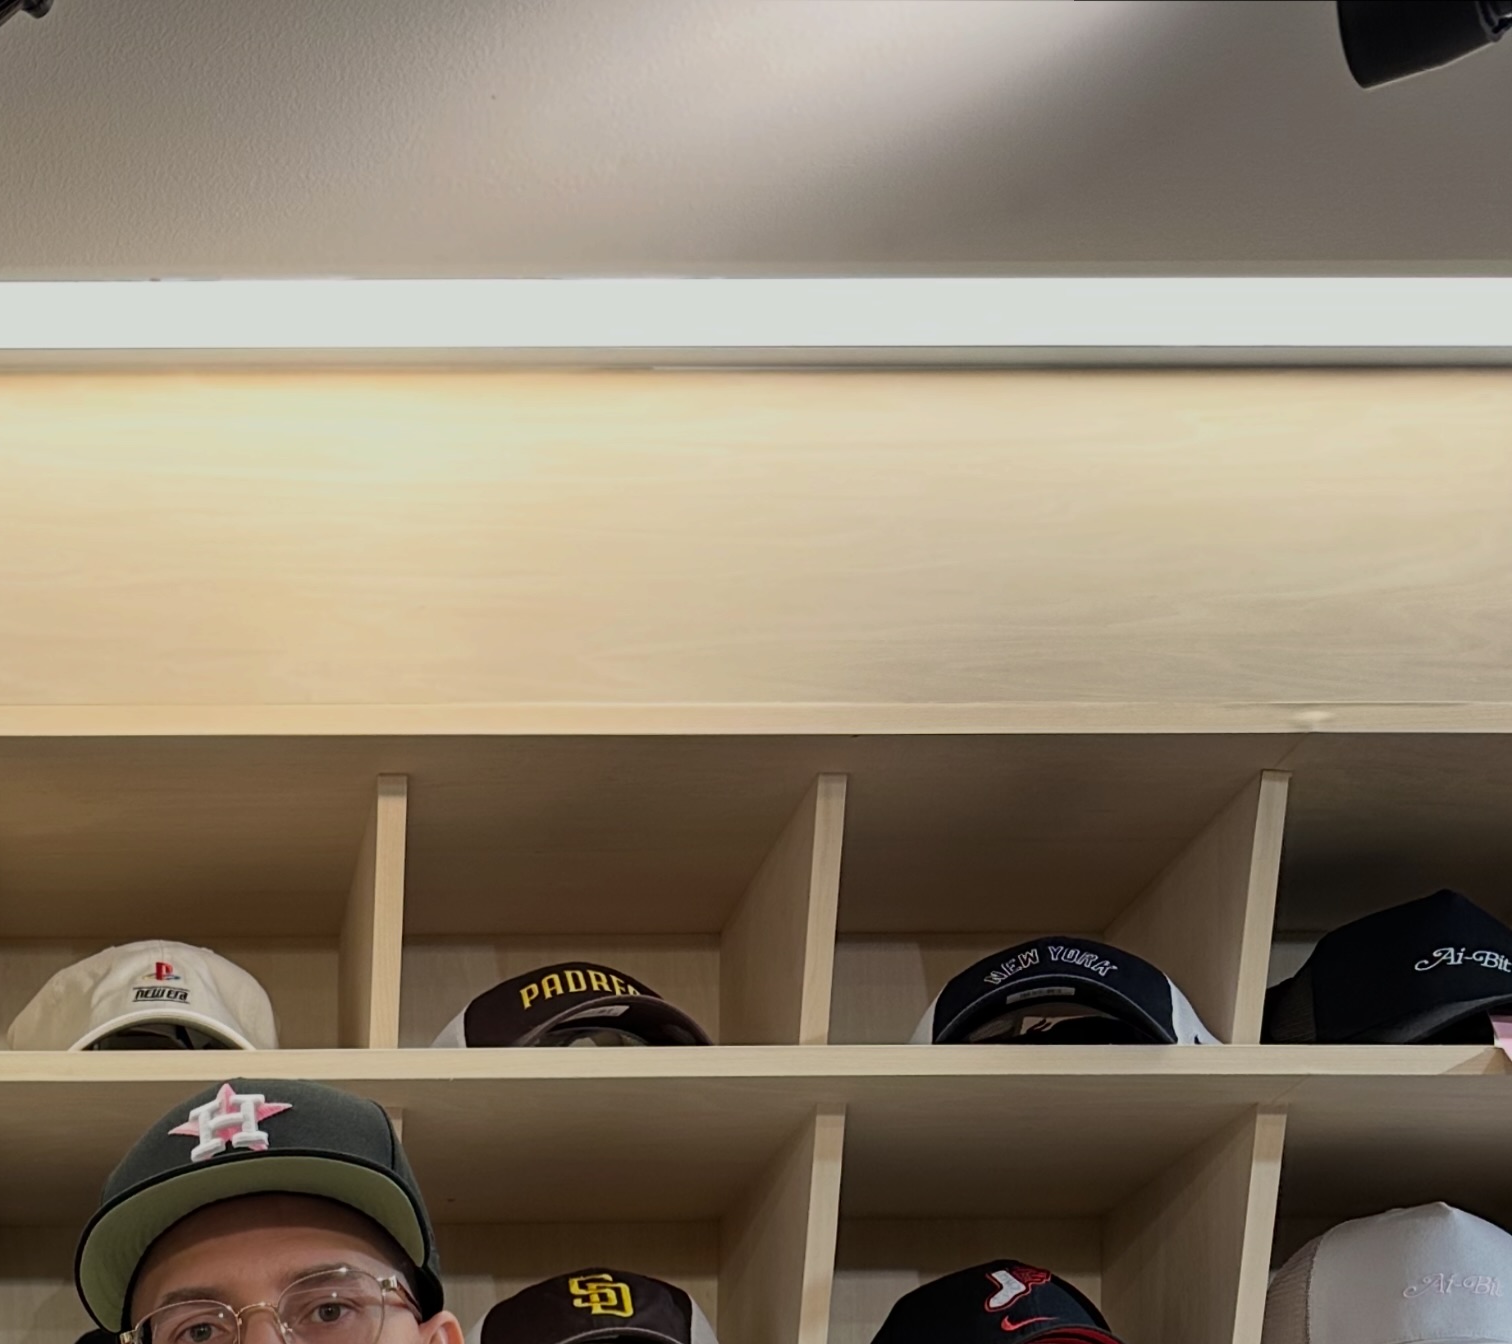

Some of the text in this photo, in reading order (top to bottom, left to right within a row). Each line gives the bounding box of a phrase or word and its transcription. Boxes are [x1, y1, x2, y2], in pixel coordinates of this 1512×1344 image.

[983, 945, 1118, 985] NEW YORK
[568, 1273, 634, 1318] SD
